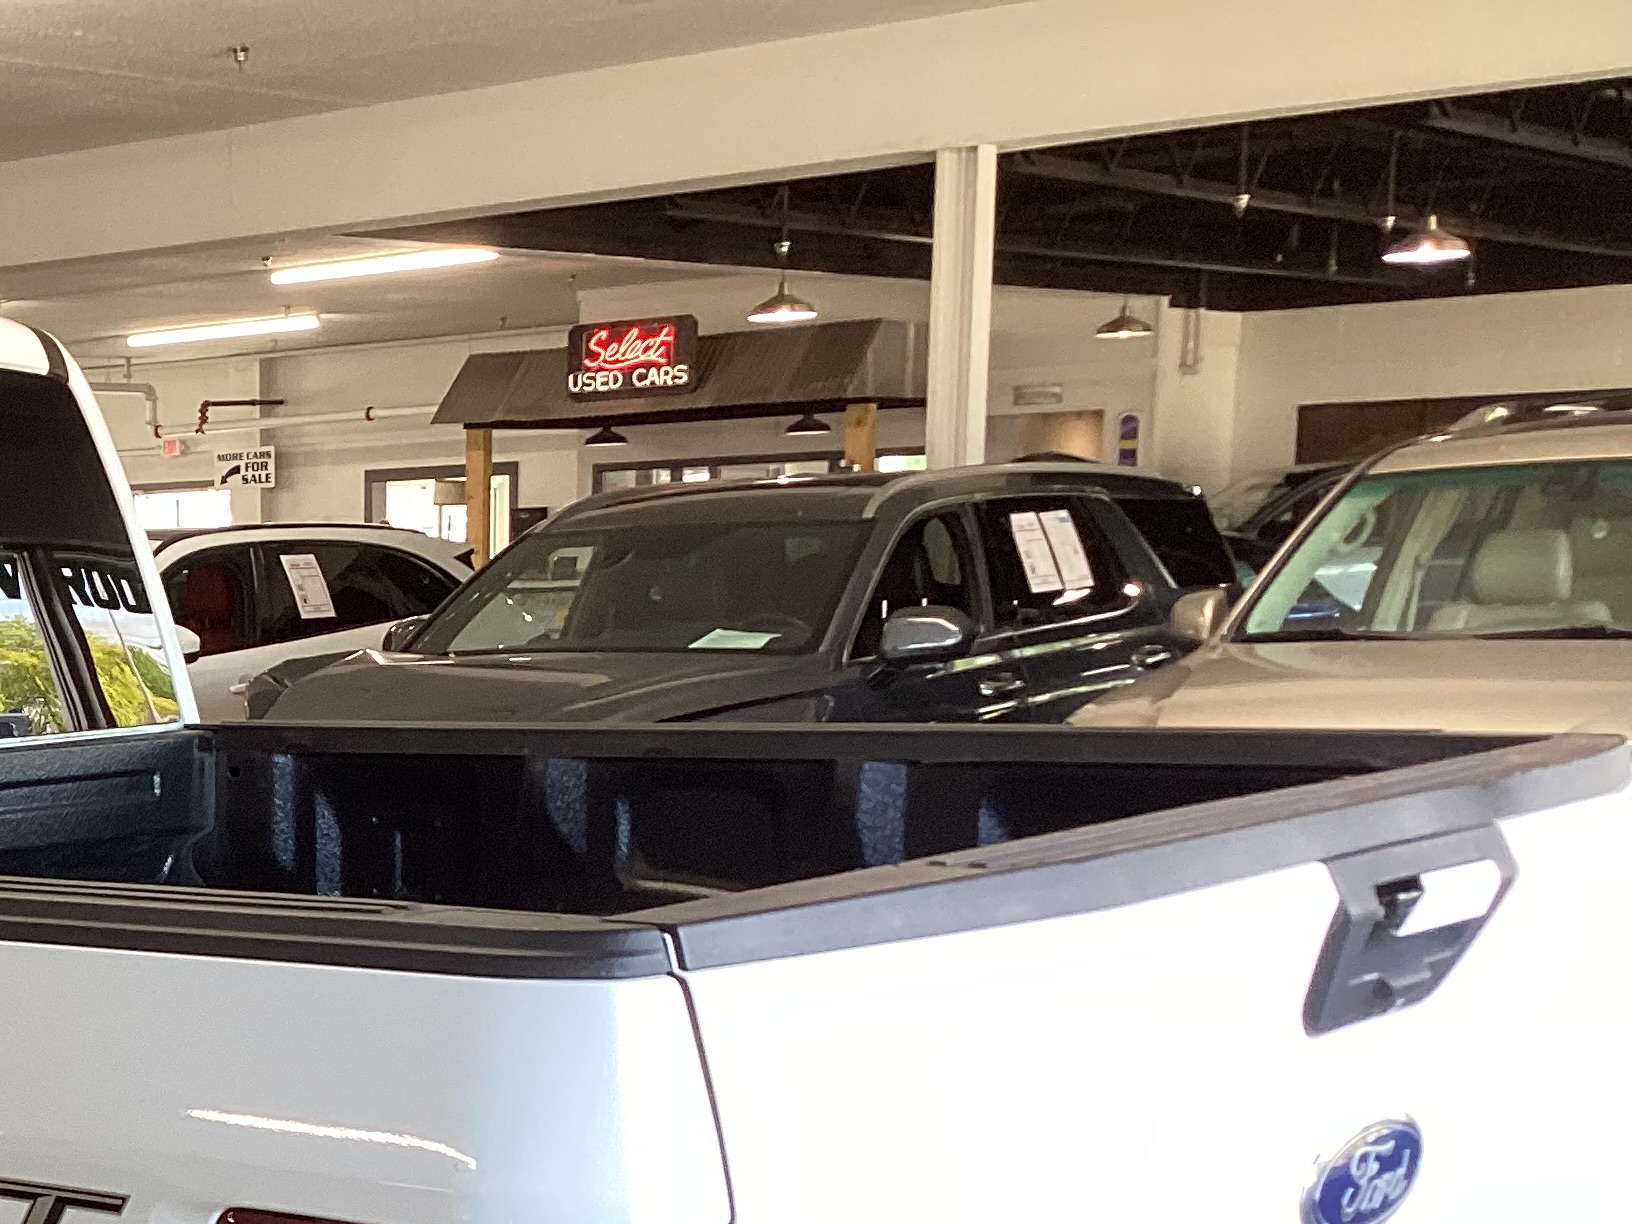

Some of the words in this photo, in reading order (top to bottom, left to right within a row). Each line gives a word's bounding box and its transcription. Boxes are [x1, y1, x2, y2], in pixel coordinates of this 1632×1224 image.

[583, 324, 673, 368] Select
[568, 370, 623, 392] USED
[632, 364, 689, 388] CARS
[217, 452, 245, 461] MORE
[246, 450, 272, 460] CARS
[245, 460, 269, 472] FOR
[241, 473, 272, 484] SALE
[1340, 1139, 1411, 1222] Ford
